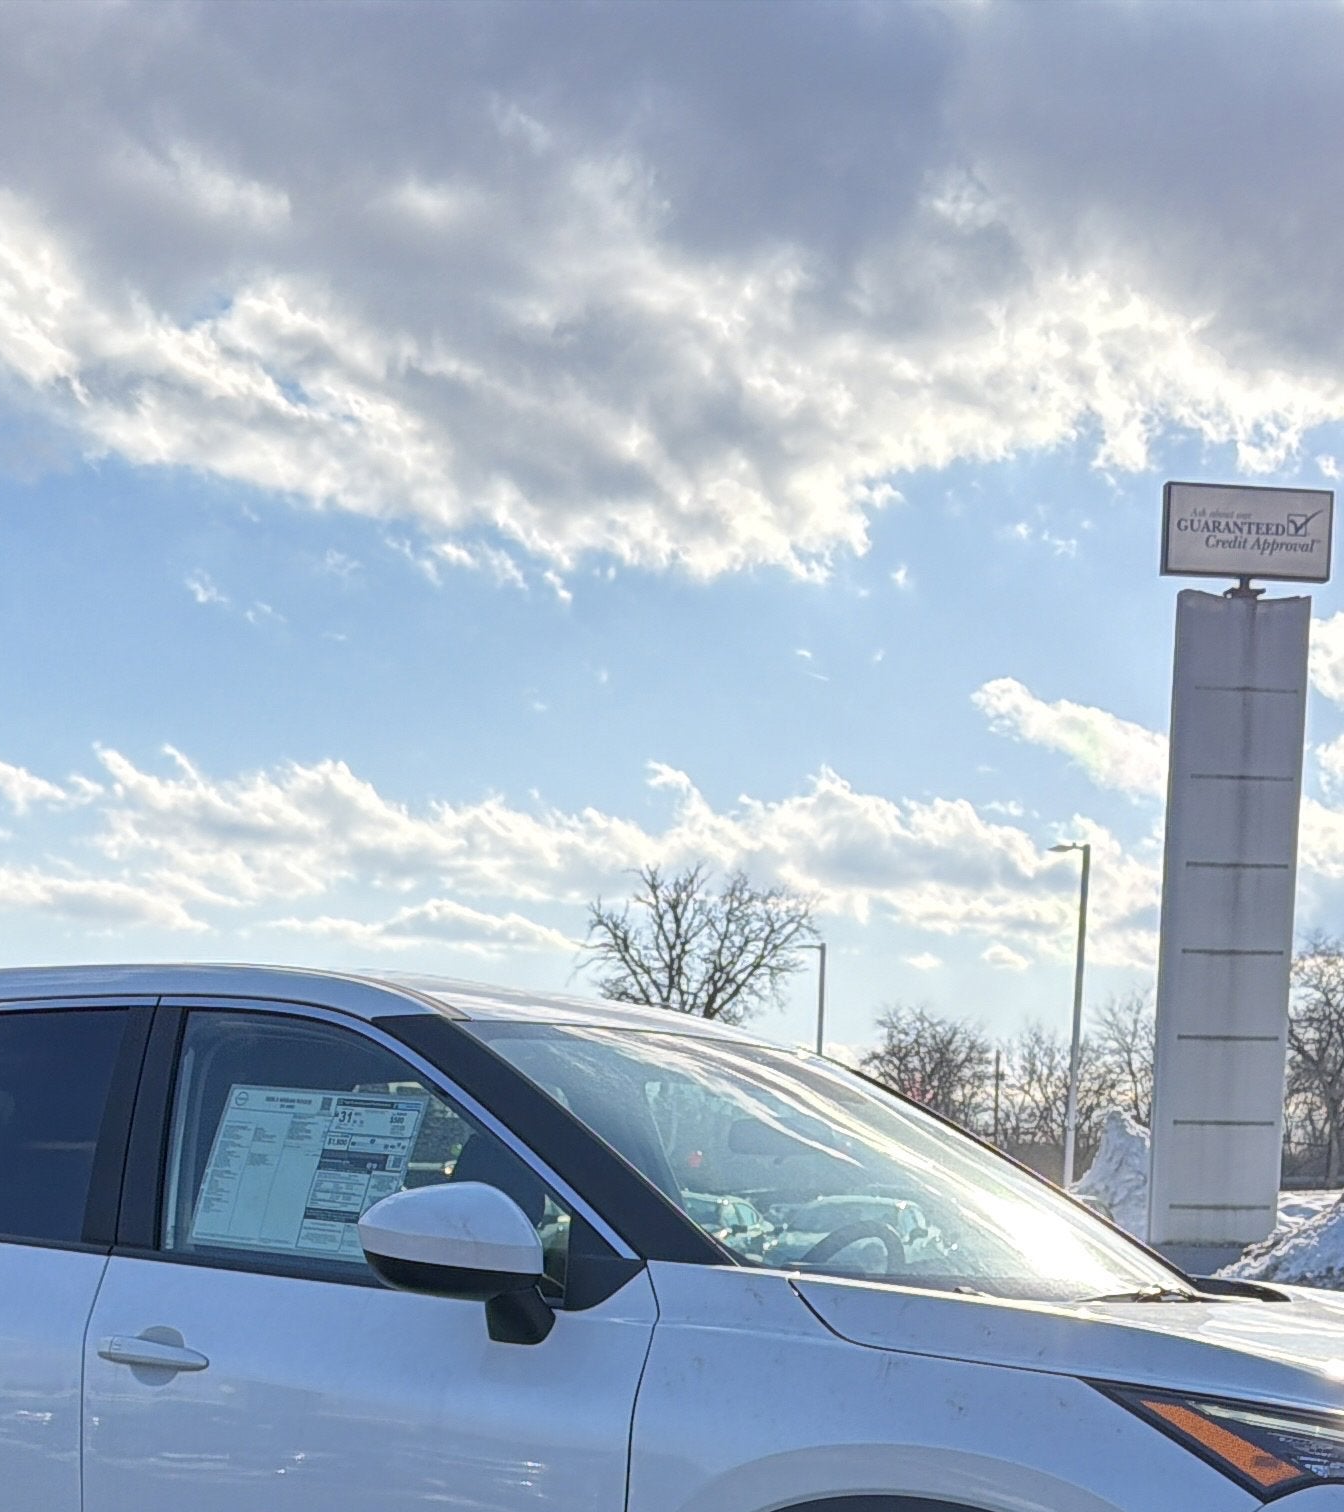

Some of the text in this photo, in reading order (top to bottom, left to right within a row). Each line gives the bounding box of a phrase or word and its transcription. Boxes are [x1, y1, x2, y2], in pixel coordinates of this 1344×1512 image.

[1176, 518, 1286, 537] GUARANTEED
[1205, 534, 1248, 550] Credit
[338, 1111, 353, 1123] 31
